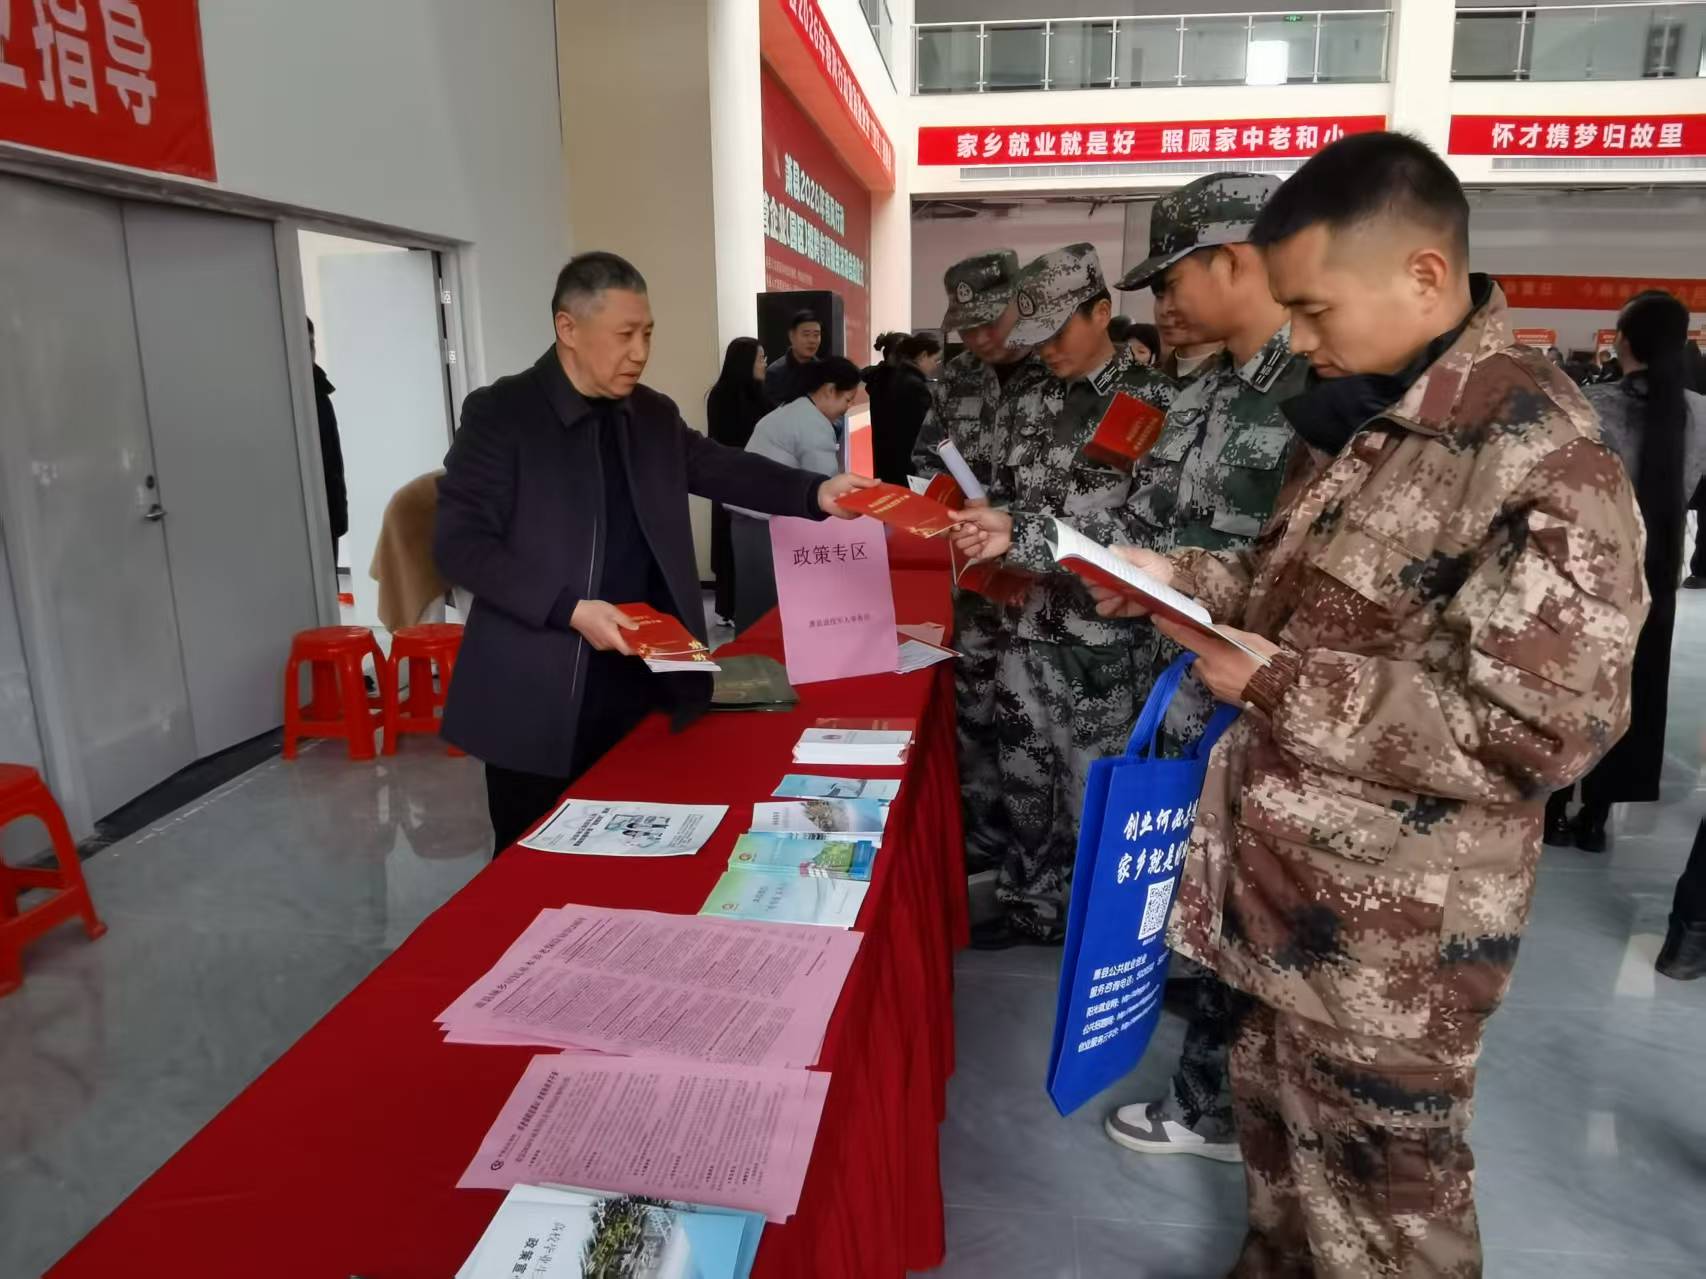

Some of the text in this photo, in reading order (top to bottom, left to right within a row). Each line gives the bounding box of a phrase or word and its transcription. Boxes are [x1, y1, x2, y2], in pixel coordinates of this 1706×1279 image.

[957, 128, 1136, 159] 家乡就业就是好
[1491, 123, 1684, 149] 怀才携梦归故里
[792, 542, 868, 566] 政策专区
[511, 1238, 539, 1279] 政策宣
